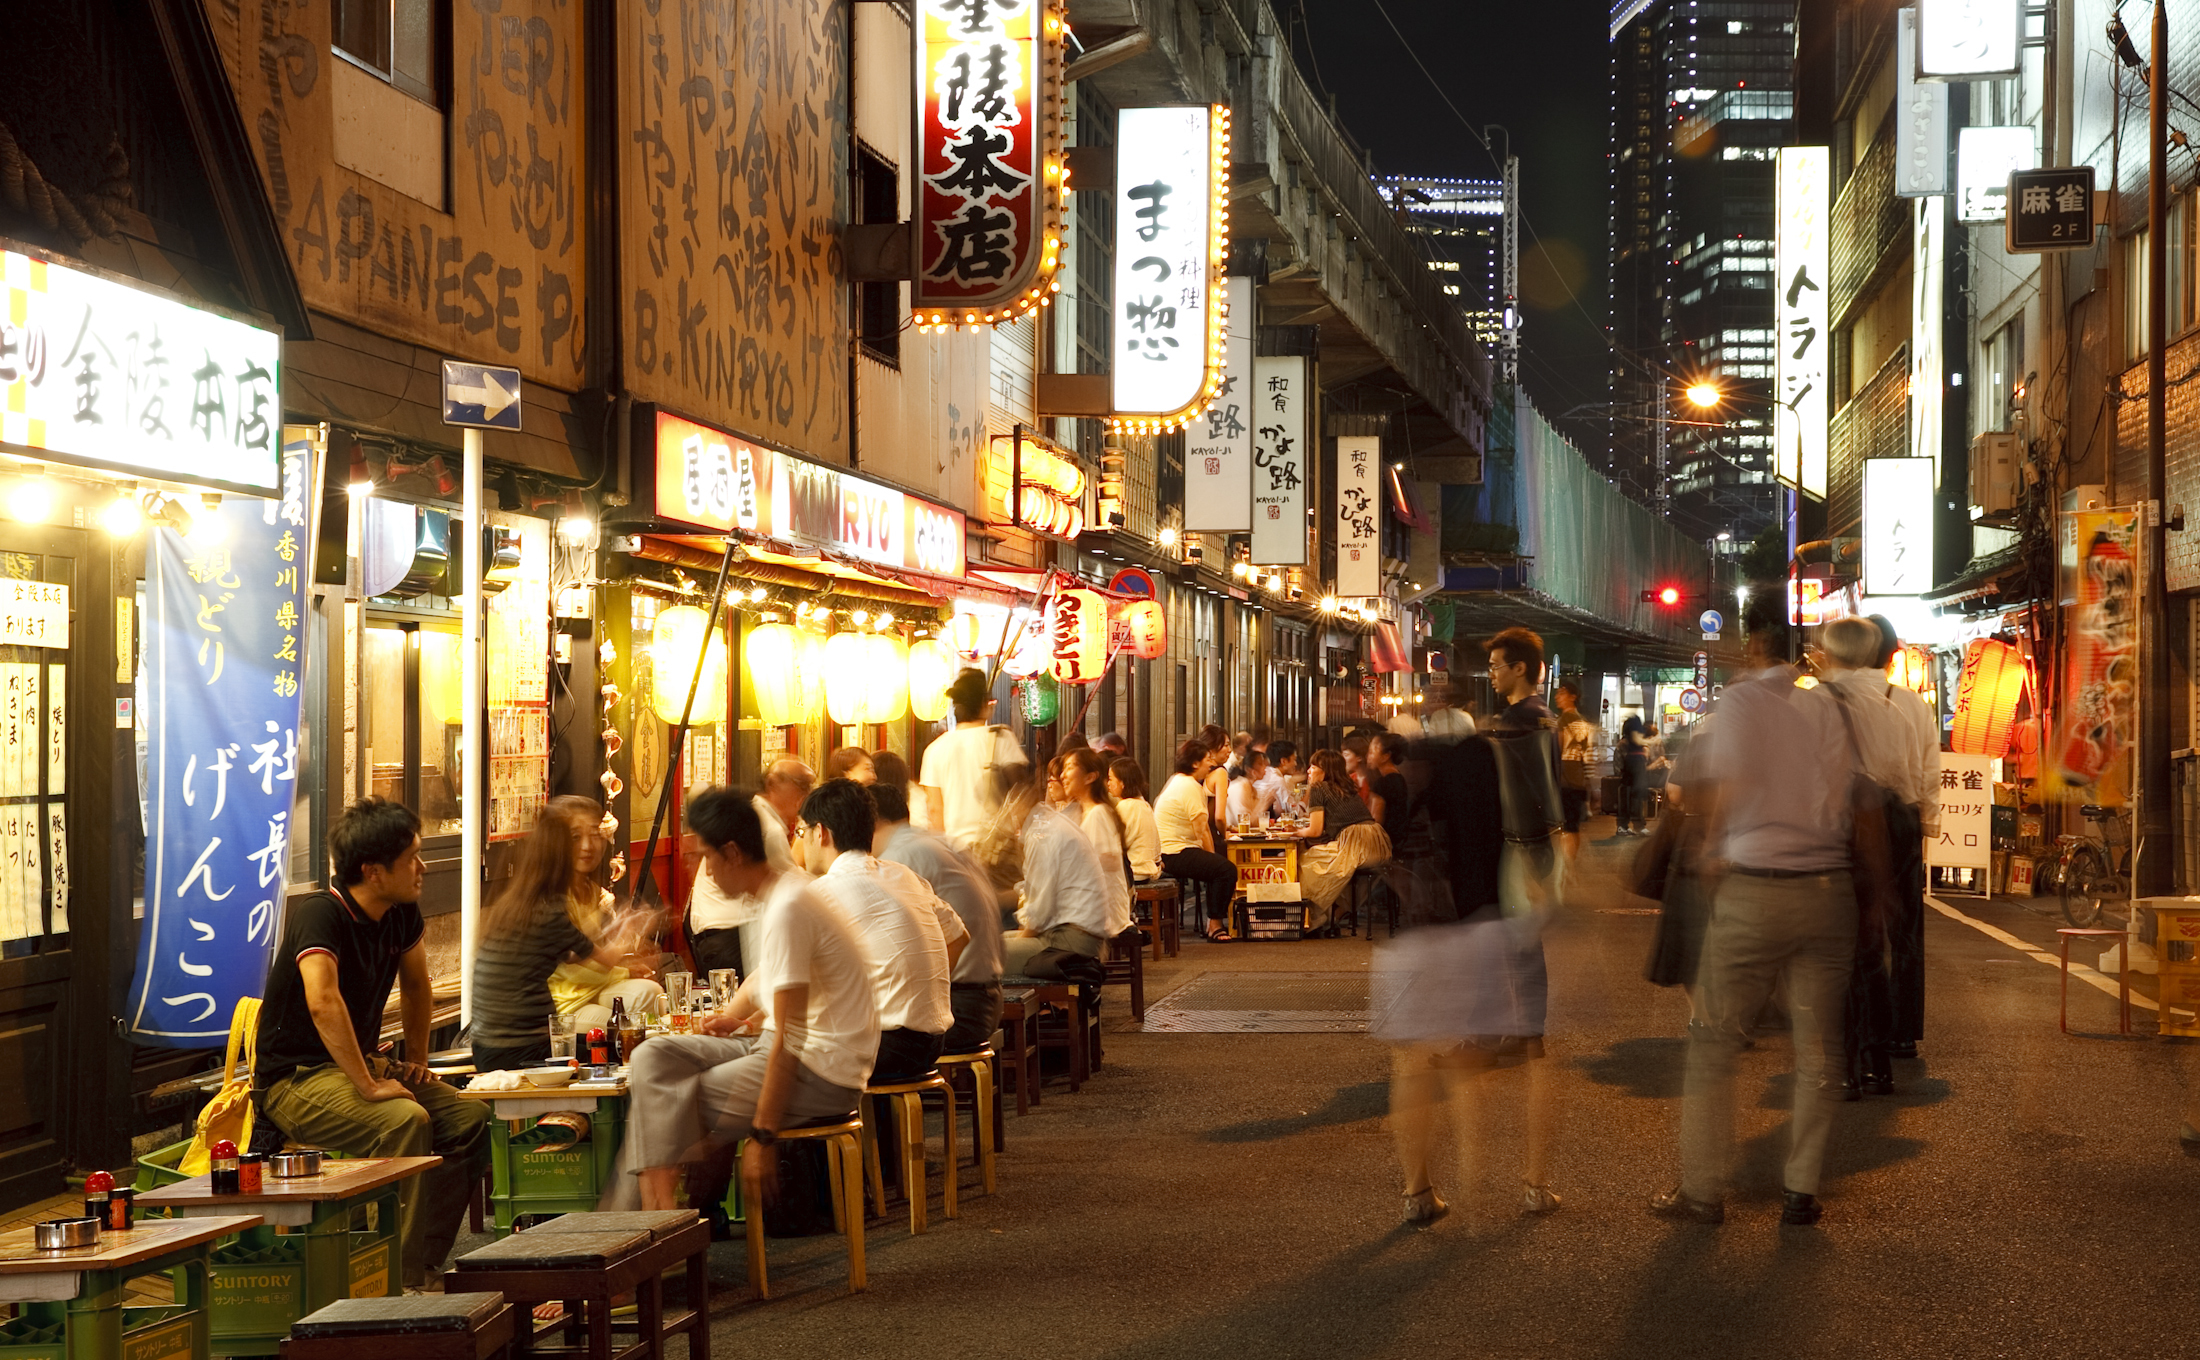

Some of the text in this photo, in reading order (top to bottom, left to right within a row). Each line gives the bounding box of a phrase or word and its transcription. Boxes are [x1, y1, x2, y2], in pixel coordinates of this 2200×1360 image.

[2020, 183, 2086, 215] 麻雀
[1126, 178, 1180, 362] まつ惣
[60, 302, 273, 452] 金陵本店
[677, 275, 795, 429] KINRYO
[1267, 376, 1290, 413] 和食
[685, 441, 756, 522] 居酒屋
[1255, 424, 1302, 490] かよひ路
[1350, 449, 1369, 479] 和食
[788, 470, 890, 553] KINRYO
[1340, 486, 1377, 539] かよひ路
[14, 583, 61, 605] 金陵本店
[187, 547, 241, 687] 親どり
[273, 530, 299, 699] 香川県名物
[6, 615, 45, 640] あります
[1051, 593, 1082, 680] やきとり
[25, 677, 37, 726] 正肉
[1957, 652, 1980, 713] ジャンボ
[52, 705, 65, 764] 焼とり
[1940, 769, 1984, 791] 麻雀
[7, 817, 19, 868] はつ
[25, 820, 37, 868] たん
[246, 719, 297, 948] 社長の
[1940, 831, 1978, 847] 入口
[51, 814, 67, 910] 豚串焼き
[161, 741, 242, 1023] げんこつ
[1241, 868, 1283, 880] KIRIN
[522, 1152, 582, 1164] SUNTORY
[523, 1168, 552, 1176] サントリー
[213, 1274, 292, 1290] SUNTORY
[354, 1262, 374, 1278] サントリー
[213, 1295, 251, 1306] サントリー
[254, 1294, 271, 1304] 中瓶
[135, 1334, 183, 1360] サントリー 中瓶
